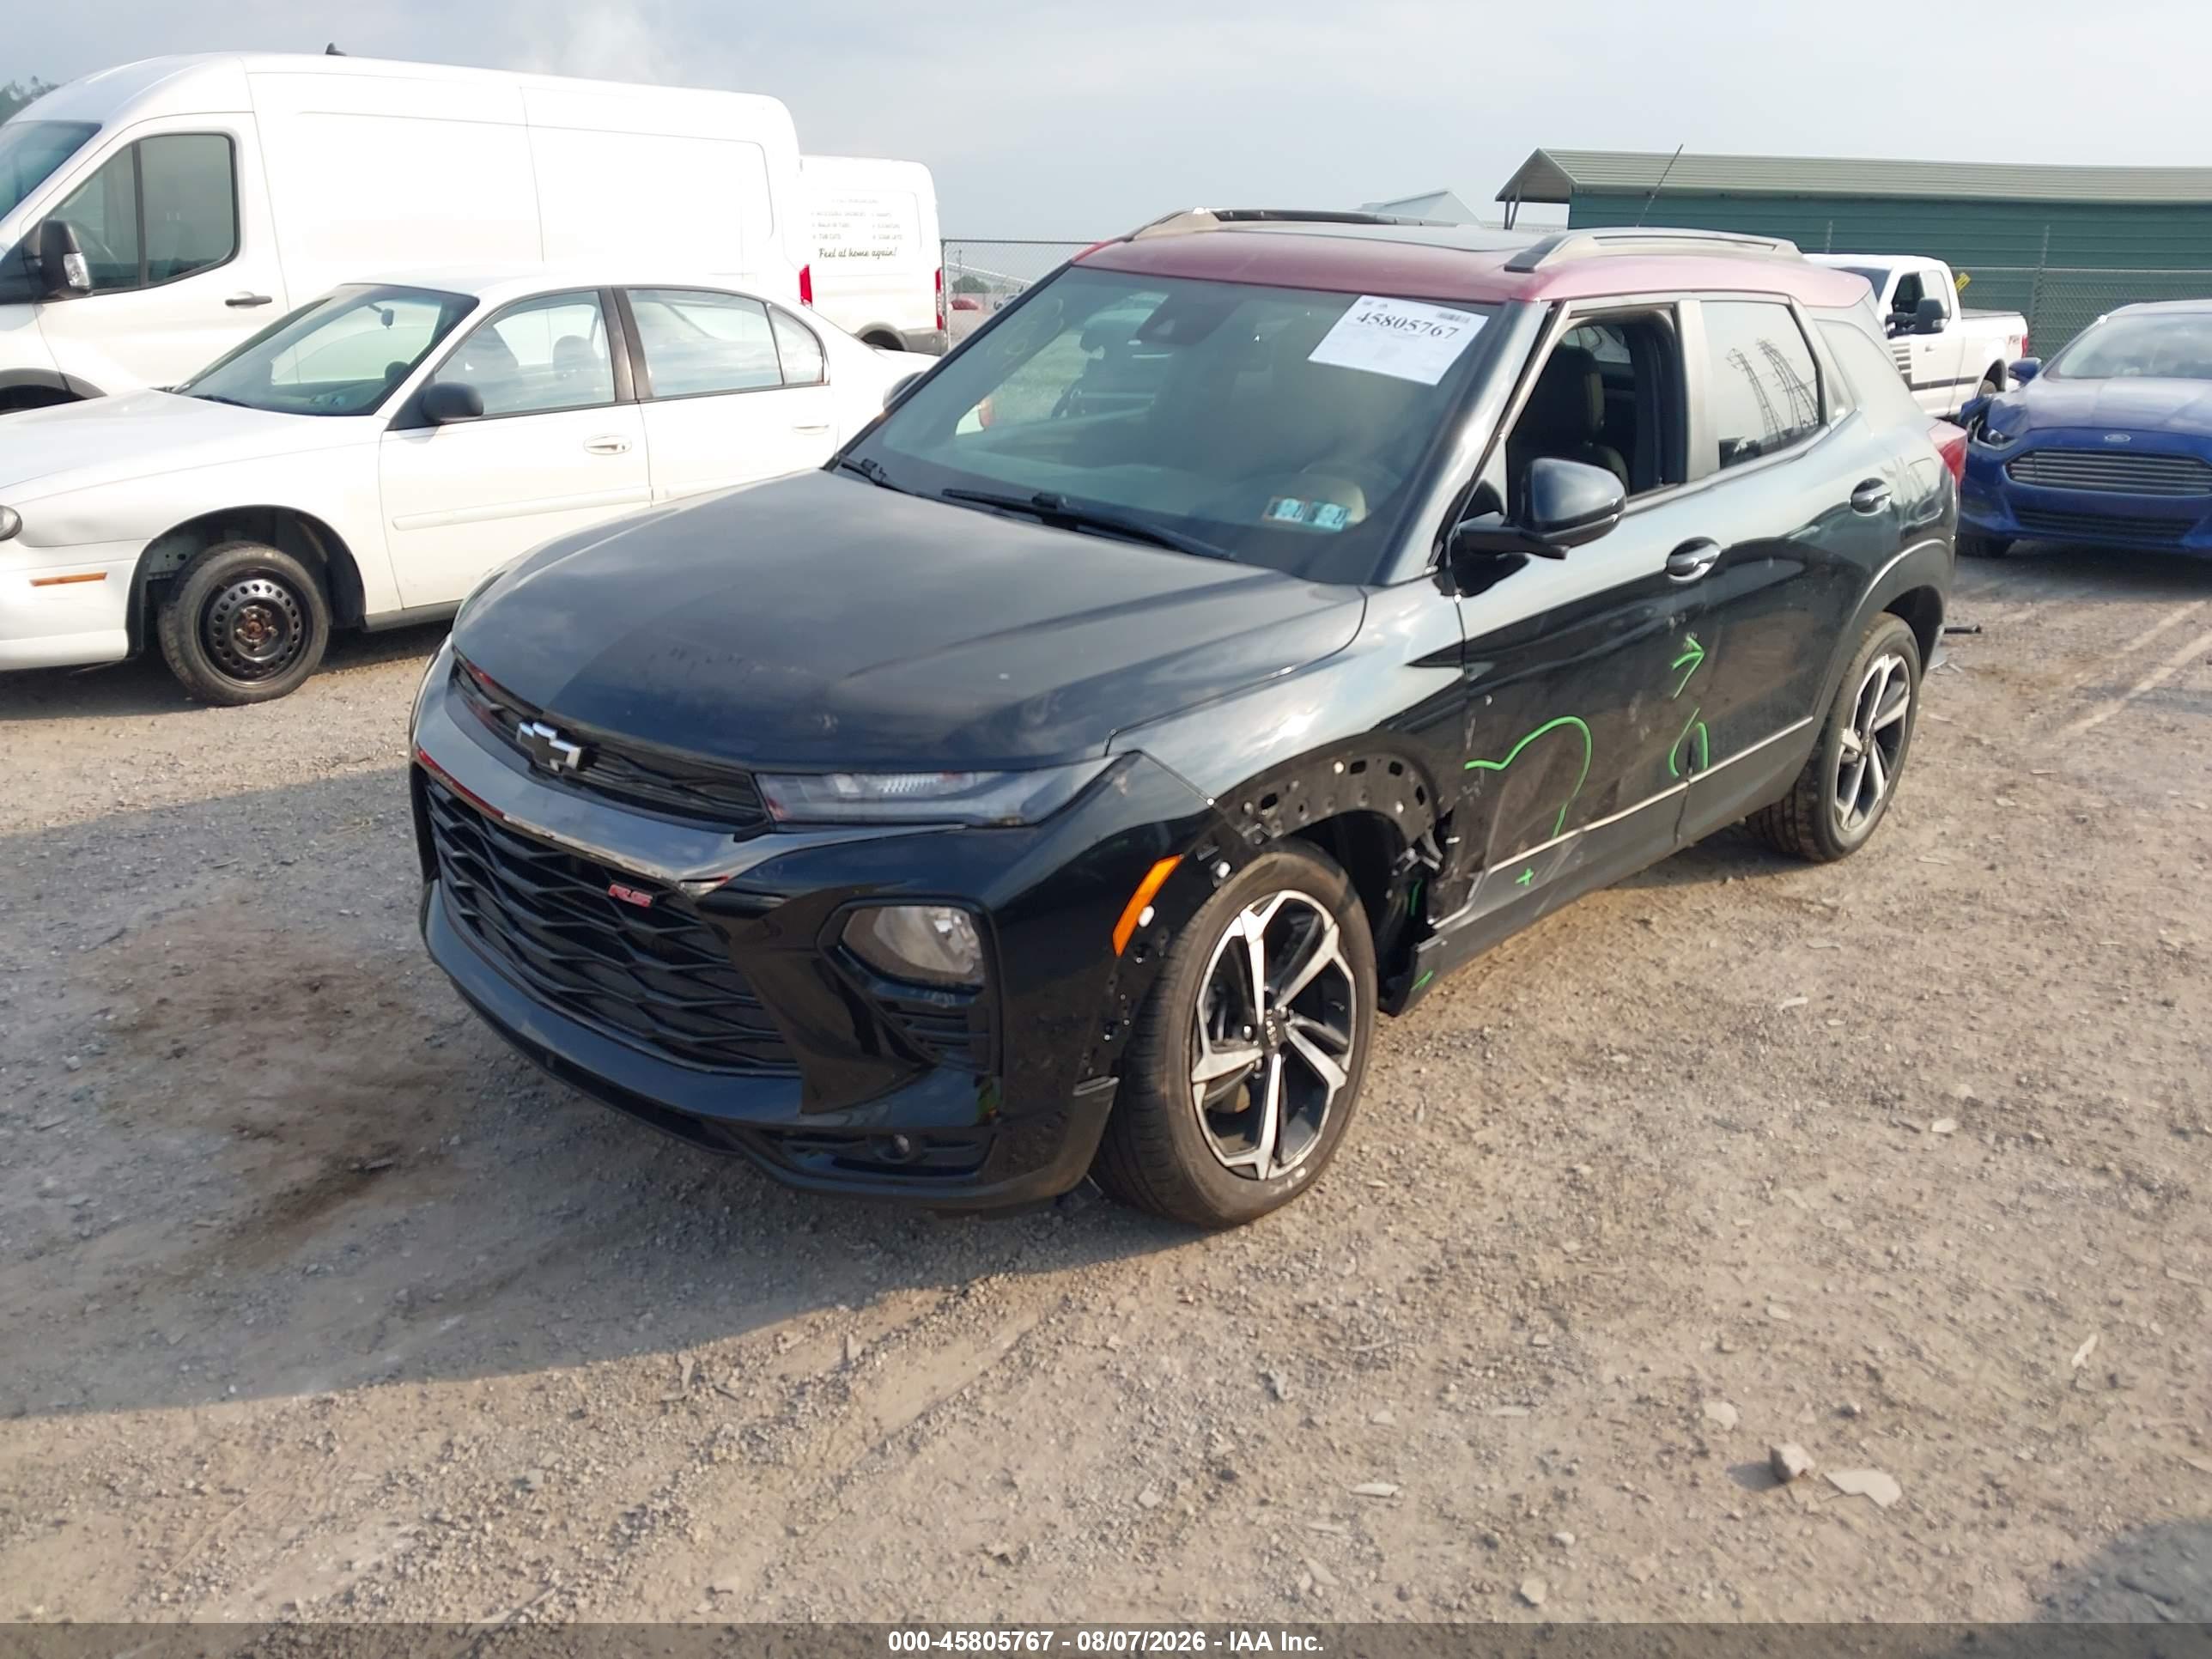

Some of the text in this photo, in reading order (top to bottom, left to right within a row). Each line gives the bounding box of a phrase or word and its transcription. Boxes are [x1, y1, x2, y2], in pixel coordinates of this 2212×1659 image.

[818, 246, 897, 259] Feel at home again!
[1357, 311, 1461, 339] 45805767
[608, 884, 653, 908] RS
